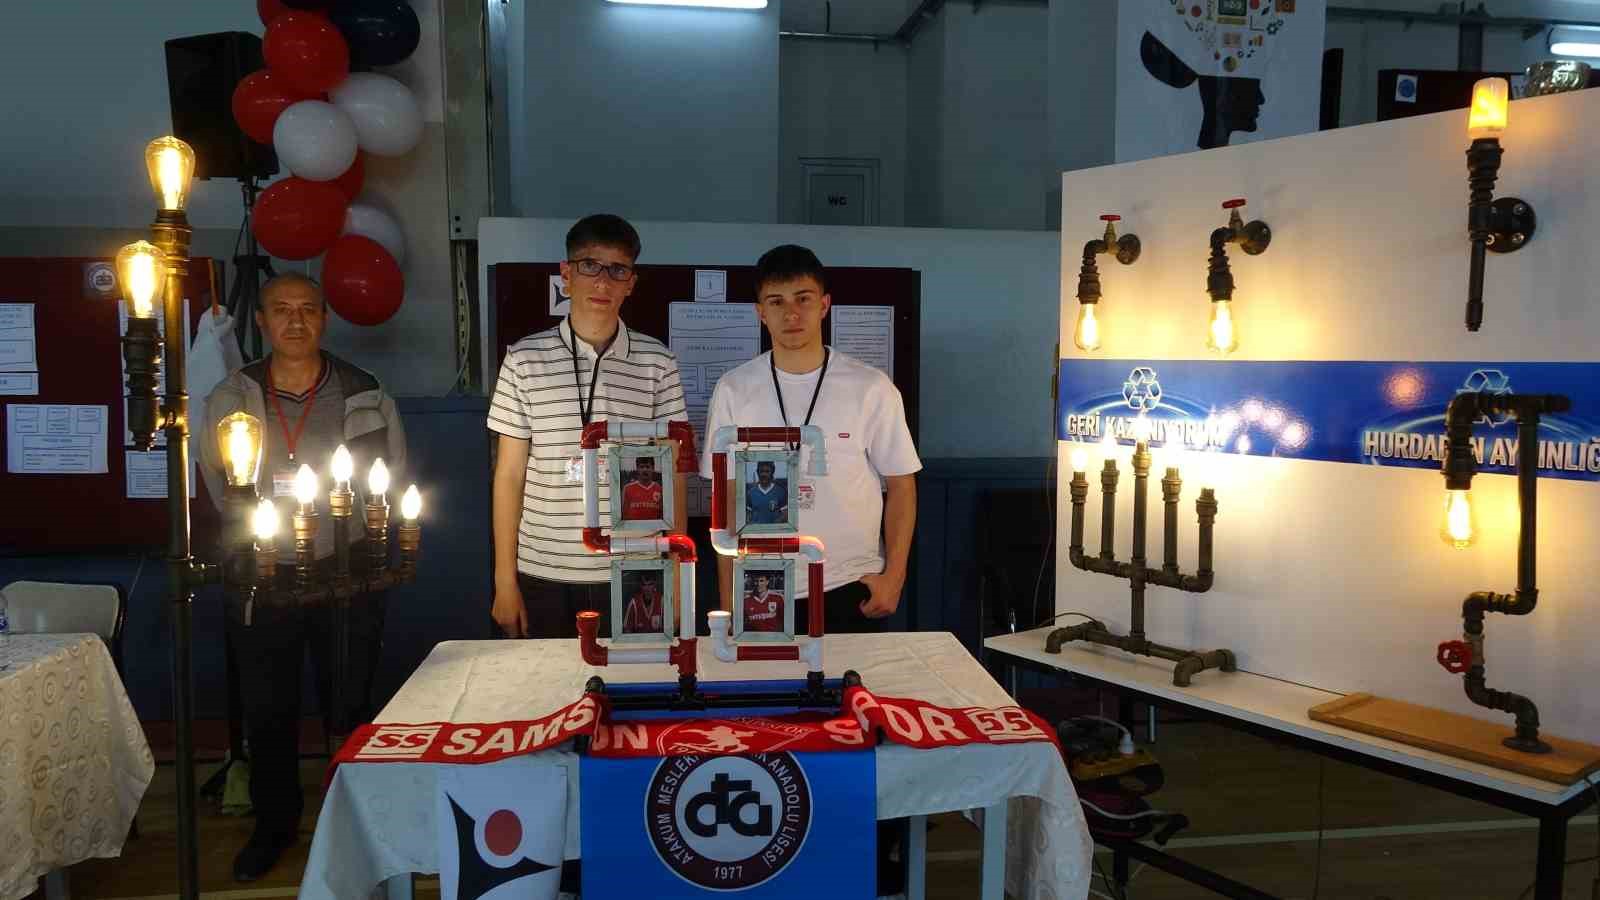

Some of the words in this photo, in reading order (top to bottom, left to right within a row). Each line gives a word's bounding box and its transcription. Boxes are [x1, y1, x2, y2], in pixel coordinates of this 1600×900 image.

[828, 195, 848, 206] WC
[1068, 412, 1100, 437] GERİ
[1489, 436, 1600, 472] AYINLIĞ
[768, 757, 801, 824] ANADOLU
[656, 813, 695, 865] ATAKUM
[762, 824, 798, 869] LİSESİ
[713, 866, 743, 880] 1977
